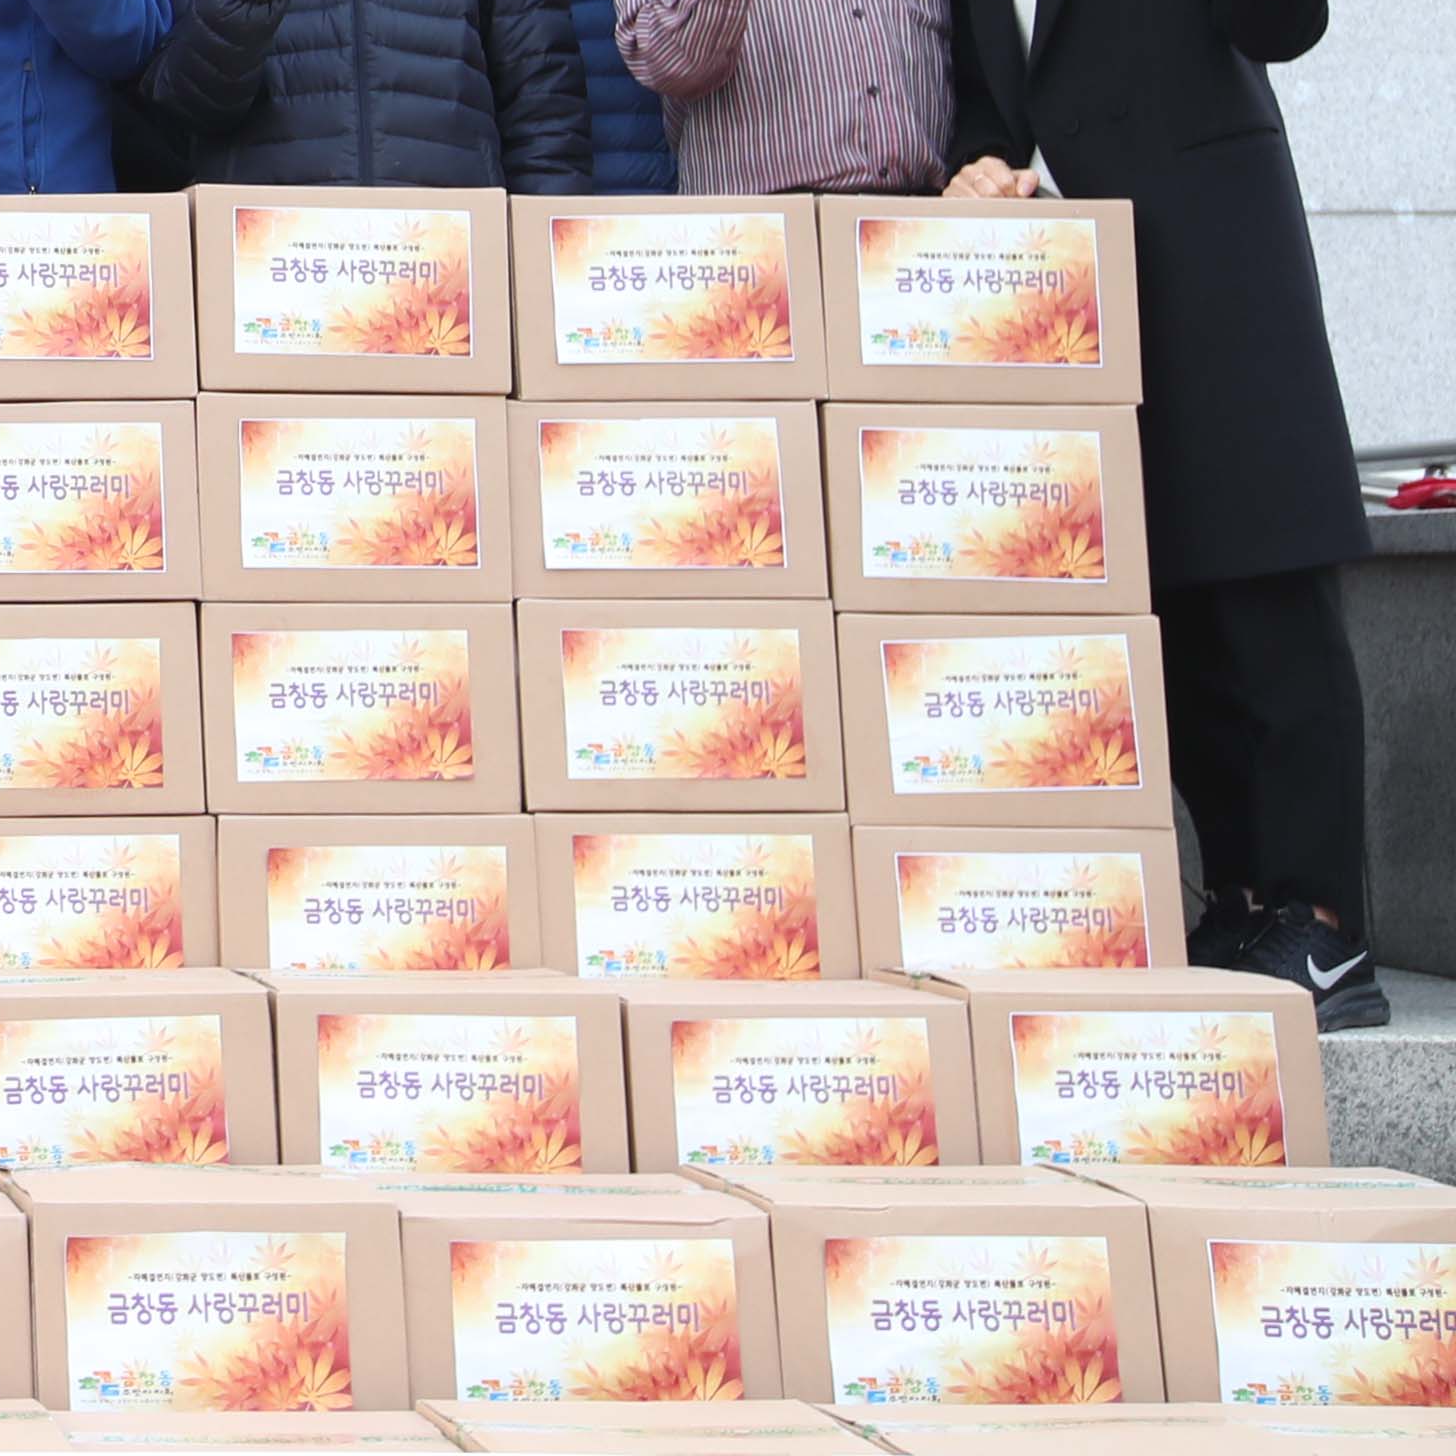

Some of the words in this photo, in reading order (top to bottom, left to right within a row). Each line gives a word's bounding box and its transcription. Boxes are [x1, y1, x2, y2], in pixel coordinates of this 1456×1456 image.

[17, 262, 119, 289] 사랑꾸러미
[269, 257, 329, 284] 금창동
[336, 259, 439, 287] 사랑꾸러미
[588, 266, 648, 291] 금창동
[655, 265, 756, 291] 사랑꾸러미
[895, 267, 955, 294] 금창동
[963, 268, 1065, 296] 사랑꾸러미
[27, 475, 130, 501] 사랑꾸러미
[276, 469, 335, 496] 금창동
[343, 470, 444, 497] 사랑꾸러미
[576, 470, 637, 497] 금창동
[644, 471, 748, 497] 사랑꾸러미
[898, 479, 959, 506] 금창동
[966, 480, 1069, 509] 사랑꾸러미
[27, 690, 130, 716] 사랑꾸러미
[268, 683, 328, 709] 금창동
[336, 682, 438, 708] 사랑꾸러미
[599, 680, 660, 706] 금창동
[667, 680, 770, 707] 사랑꾸러미
[923, 691, 986, 719] 금창동
[993, 689, 1100, 717] 사랑꾸러미
[45, 887, 149, 915] 사랑꾸러미
[303, 898, 364, 925] 금창동
[372, 898, 476, 925] 사랑꾸러미
[610, 885, 672, 913] 금창동
[679, 886, 784, 913] 사랑꾸러미
[937, 907, 1000, 934] 금창동
[1006, 907, 1113, 935] 사랑꾸러미
[3, 1075, 69, 1105] 금창동
[77, 1072, 189, 1104] 사랑꾸러미
[356, 1070, 422, 1100] 금창동
[431, 1071, 544, 1103] 사랑꾸러미
[712, 1075, 778, 1104] 금창동
[786, 1075, 898, 1104] 사랑꾸러미
[1054, 1070, 1122, 1100] 금창동
[1129, 1070, 1245, 1101] 사랑꾸러미
[107, 1293, 178, 1325] 금창동
[187, 1292, 309, 1324] 사랑꾸러미
[495, 1303, 568, 1335] 금창동
[577, 1303, 700, 1335] 사랑꾸러미
[870, 1299, 943, 1332] 금창동
[951, 1300, 1076, 1333] 사랑꾸러미
[1260, 1305, 1335, 1339] 금창동
